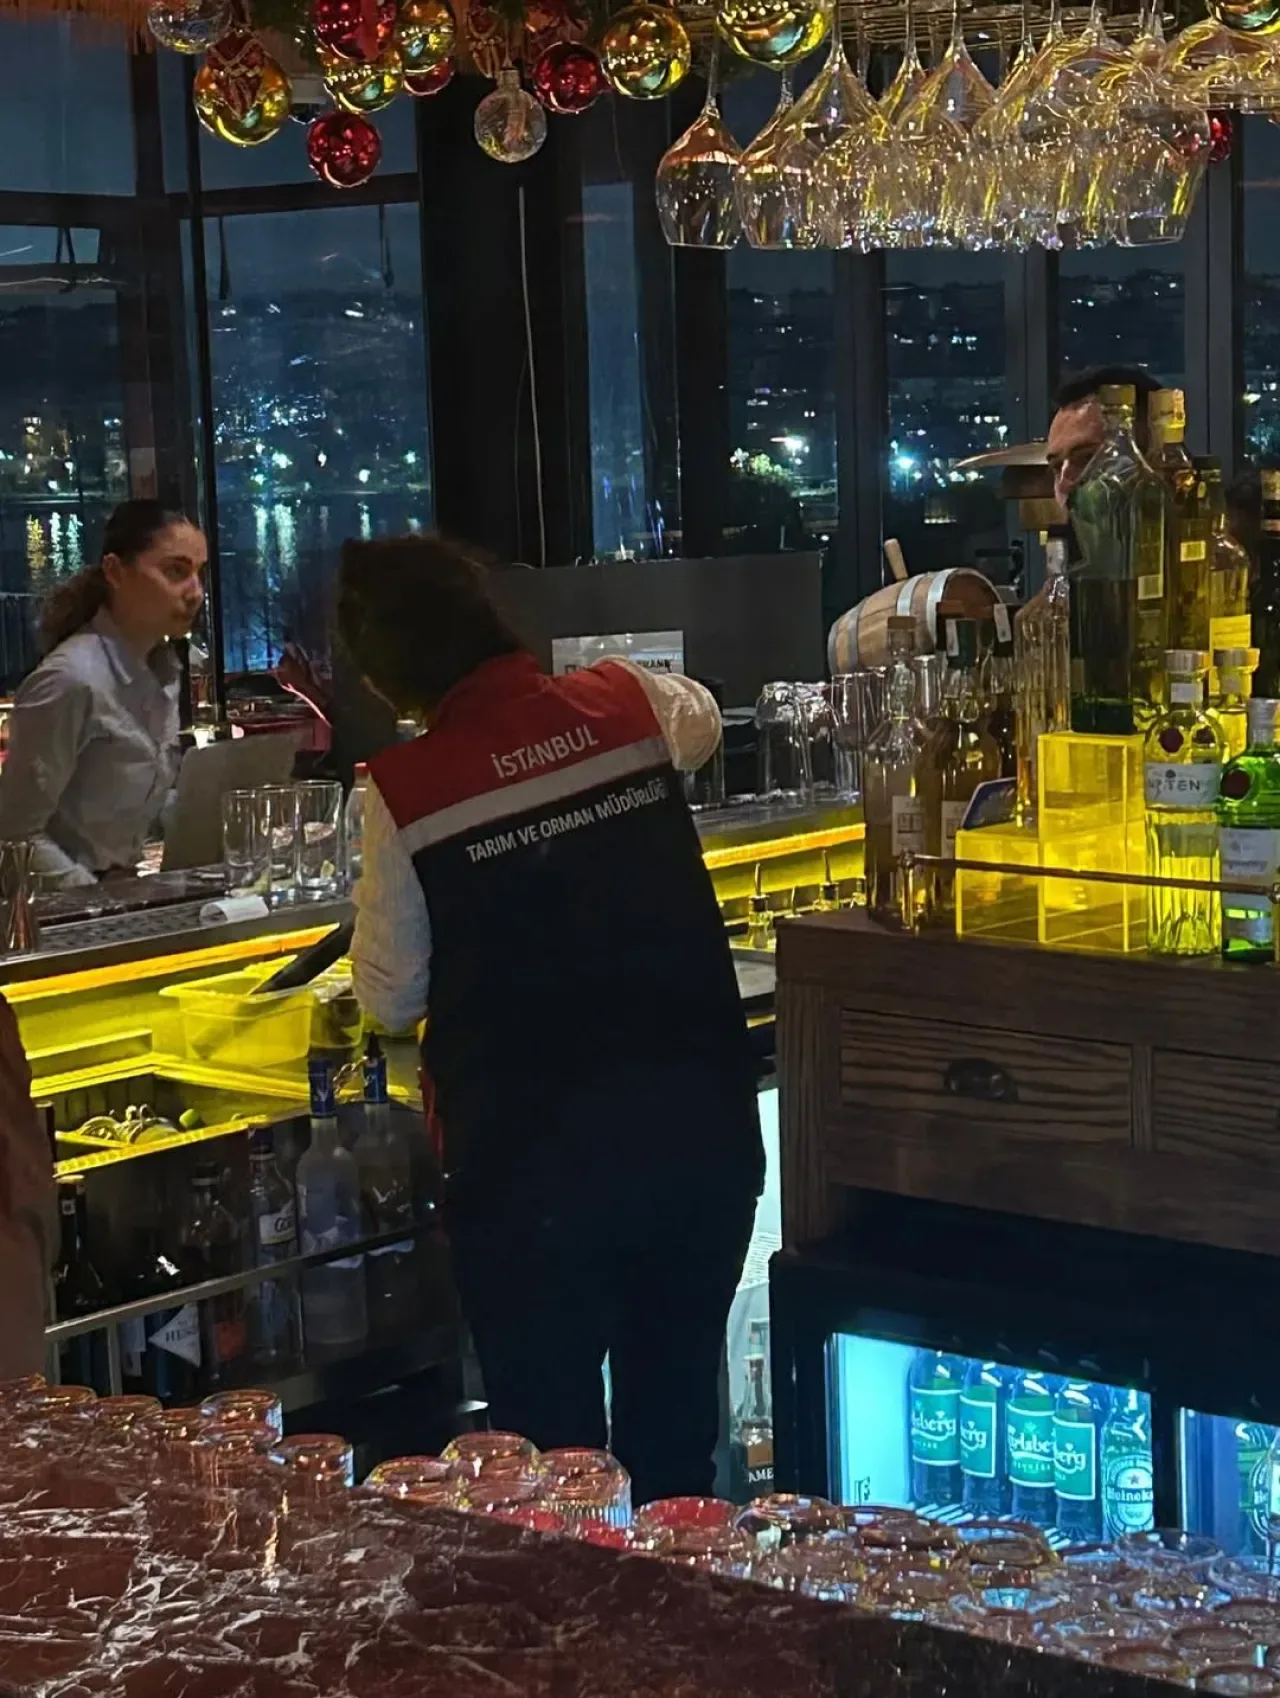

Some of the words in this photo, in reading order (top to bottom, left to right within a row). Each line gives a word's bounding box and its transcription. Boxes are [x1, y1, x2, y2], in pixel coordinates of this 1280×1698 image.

[491, 724, 599, 778] İSTANBUL
[466, 832, 517, 864] TARIM
[518, 824, 540, 845] VE
[540, 807, 596, 837] ORMAN
